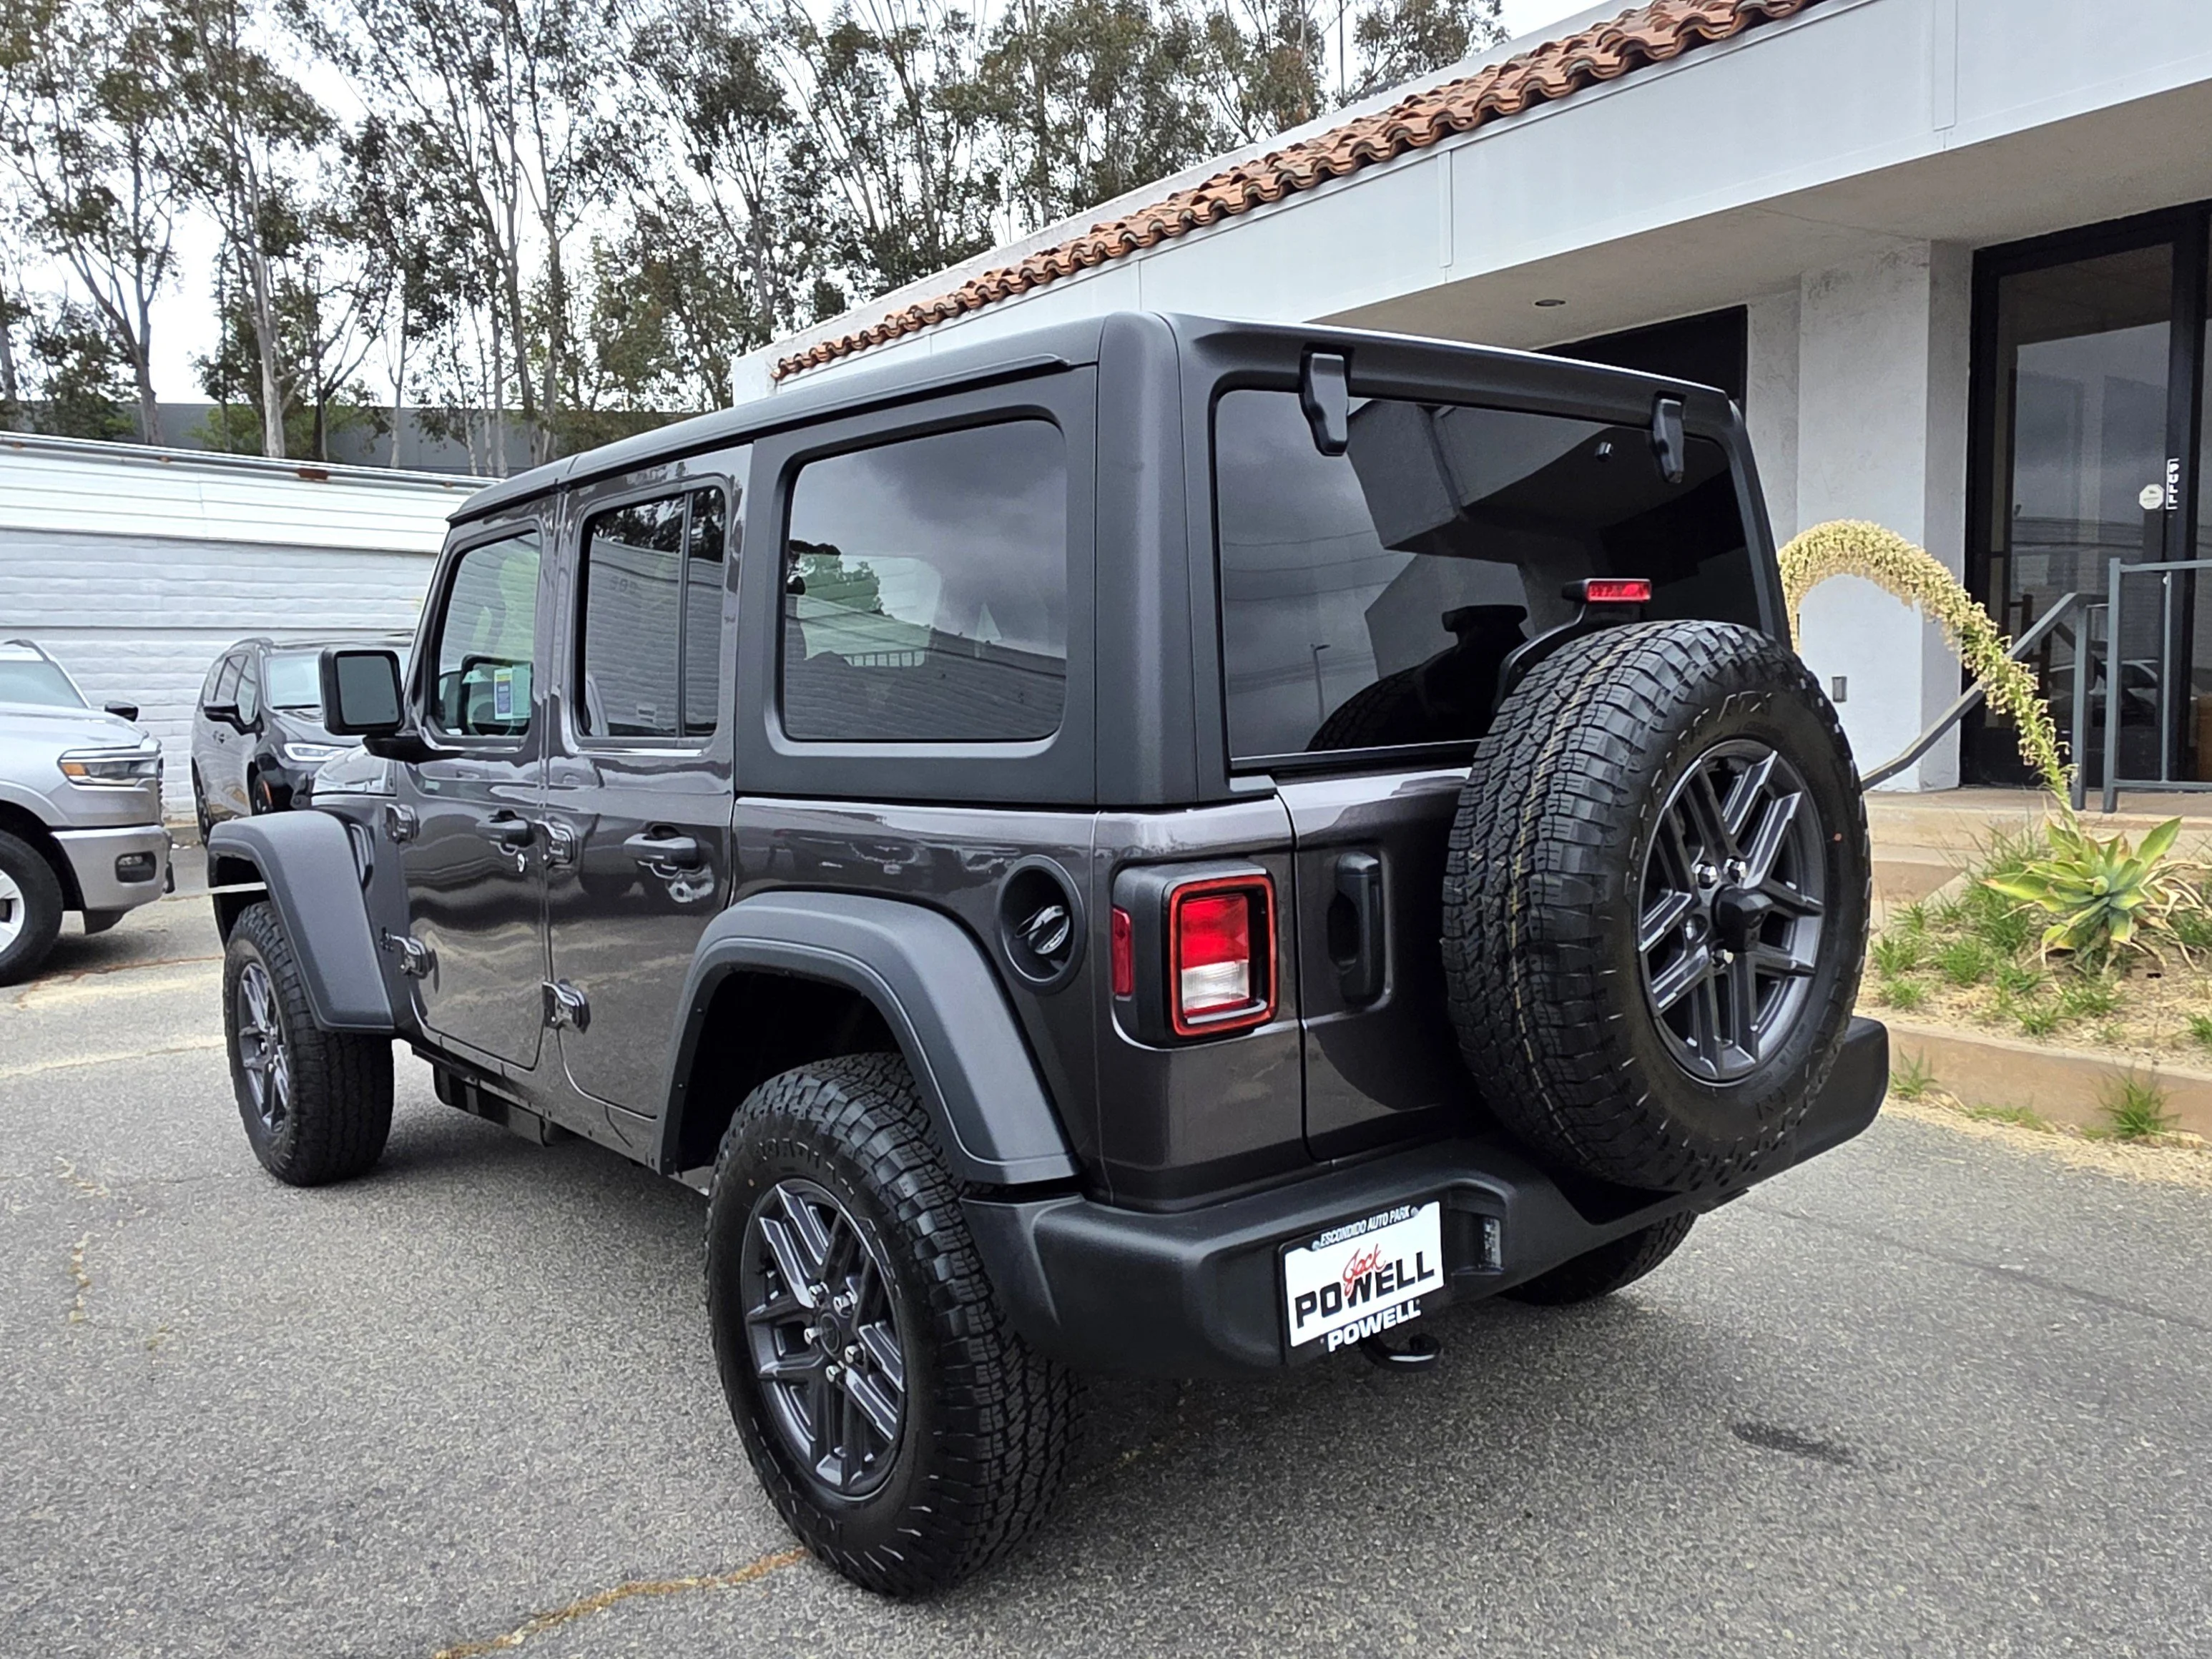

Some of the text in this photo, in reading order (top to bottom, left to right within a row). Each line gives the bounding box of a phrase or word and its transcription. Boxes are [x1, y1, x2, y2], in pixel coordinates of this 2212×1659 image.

[2168, 463, 2180, 503] PULL
[1320, 1205, 1412, 1246] ESCONDIDO AUTO PARK
[1295, 1251, 1435, 1329] POWELL
[1342, 1244, 1385, 1297] Jack
[1328, 1299, 1421, 1352] POWELL
